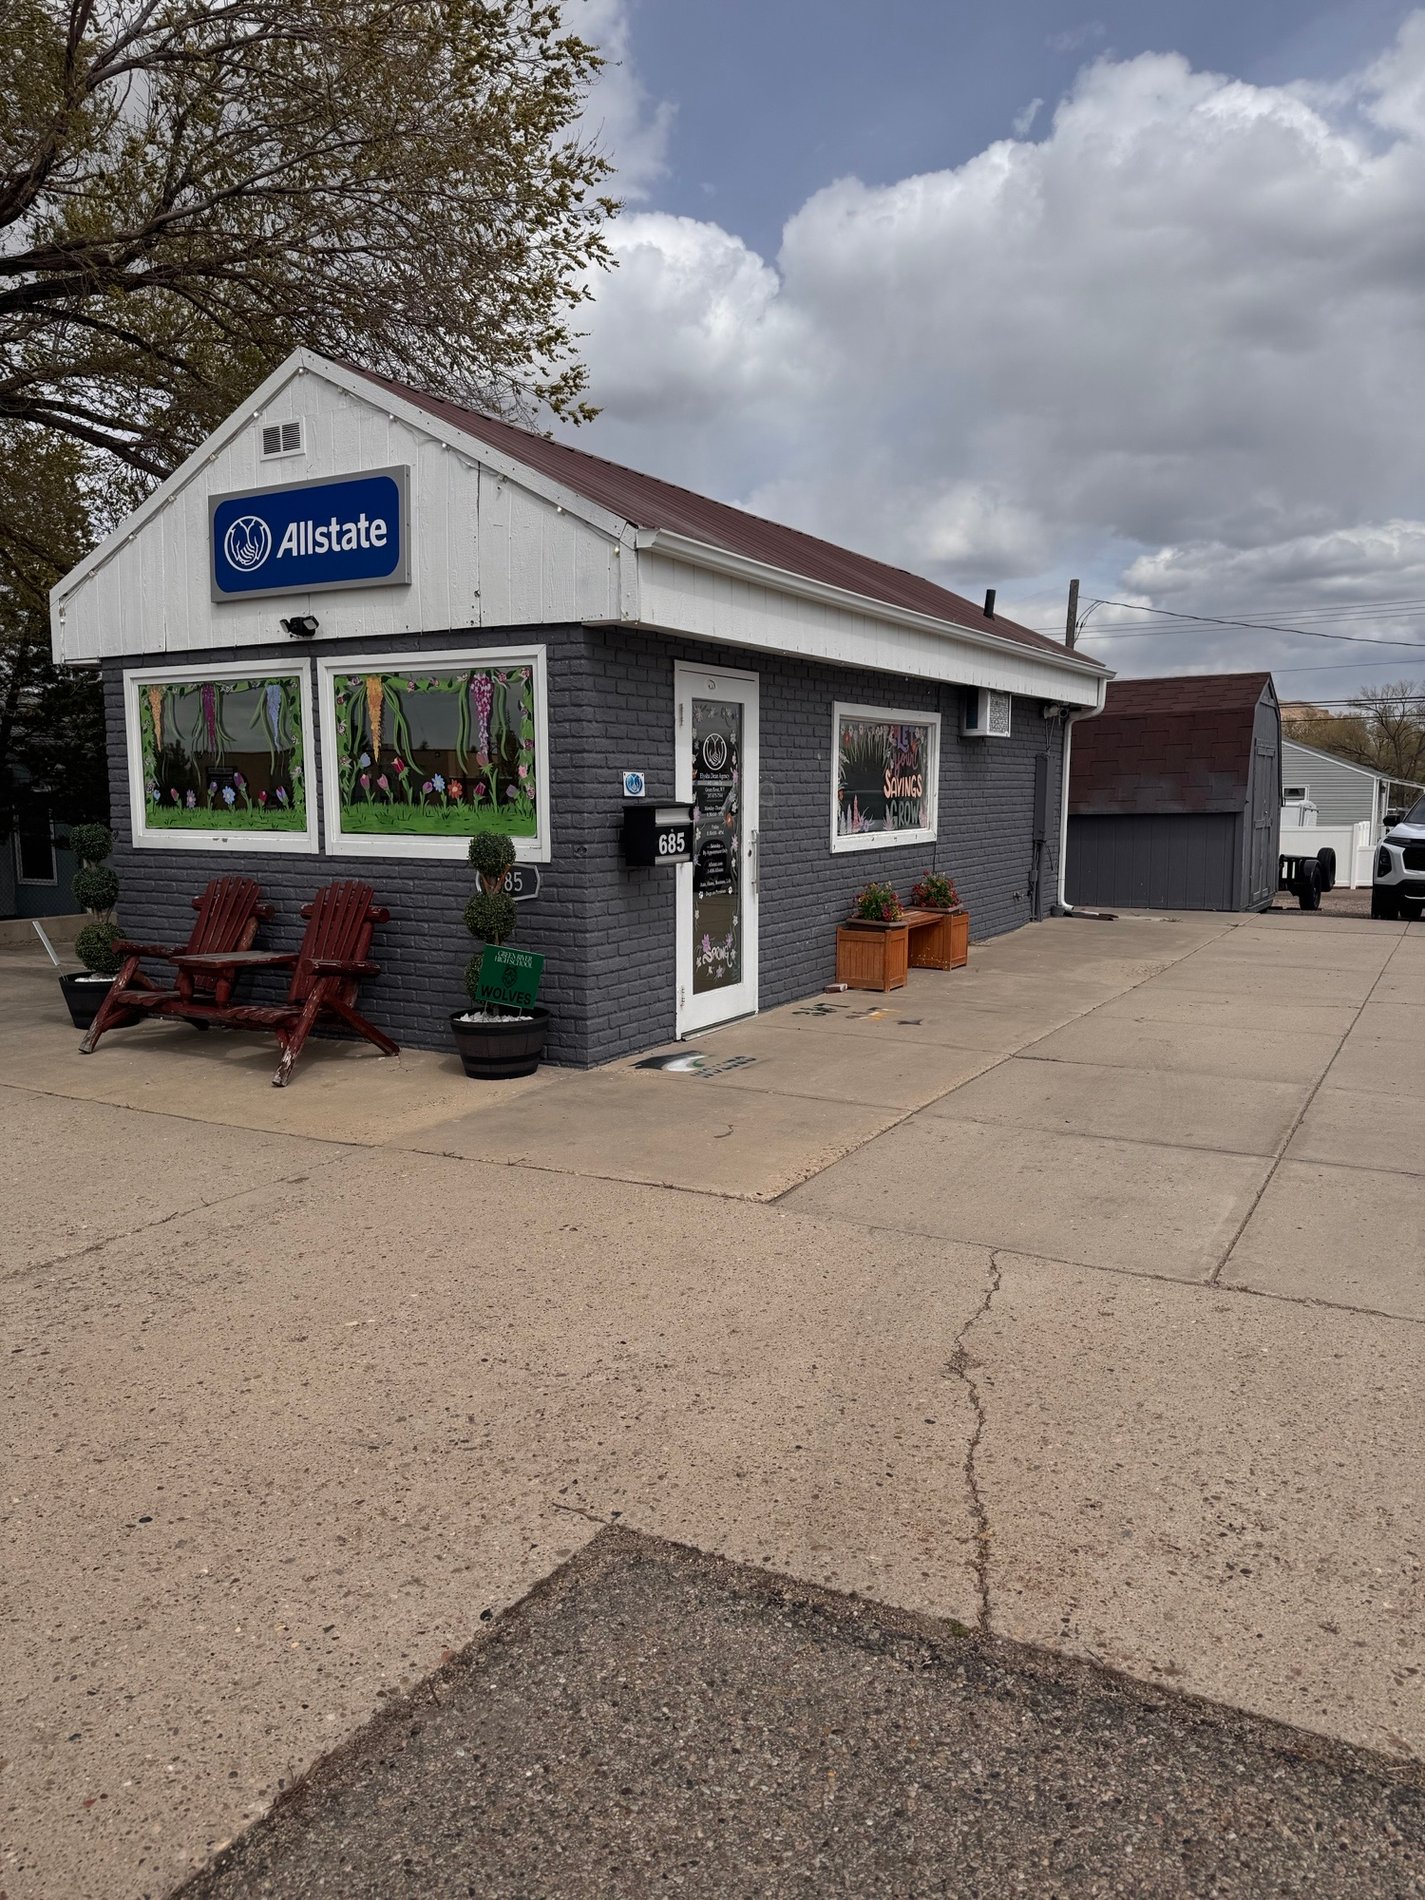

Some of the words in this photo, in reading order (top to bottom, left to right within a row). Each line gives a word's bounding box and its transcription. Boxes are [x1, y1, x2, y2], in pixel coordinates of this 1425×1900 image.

[276, 513, 388, 559] Allstate
[890, 800, 920, 826] GROW
[658, 831, 686, 855] 685
[500, 871, 523, 892] 85
[480, 984, 532, 1005] WOLVES
